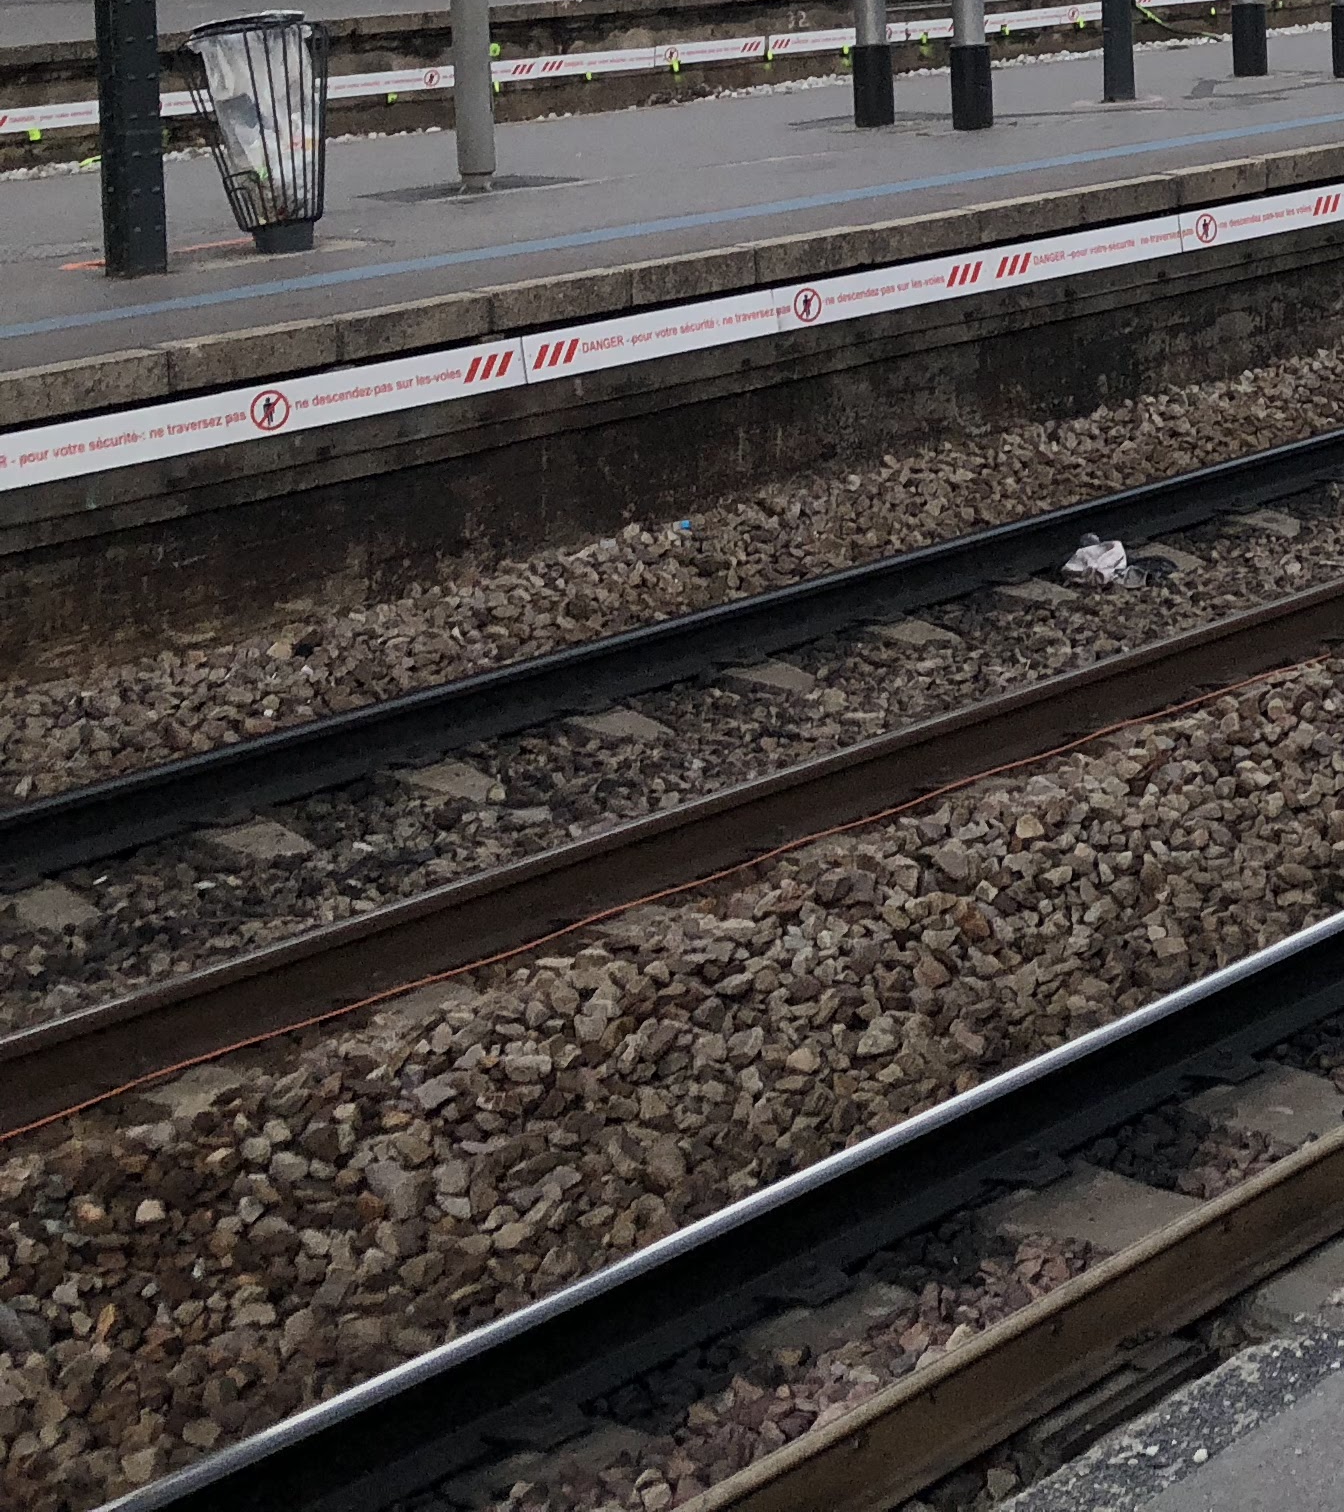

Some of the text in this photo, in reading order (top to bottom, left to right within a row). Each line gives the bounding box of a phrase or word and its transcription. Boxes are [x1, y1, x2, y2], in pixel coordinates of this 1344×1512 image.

[581, 334, 625, 354] DANGER
[631, 332, 653, 347] pour
[654, 325, 678, 339] votre
[722, 316, 734, 326] ne
[775, 304, 792, 318] pas
[294, 398, 310, 411] ne
[373, 381, 394, 398] pas
[395, 377, 413, 390] sur
[415, 374, 432, 387] les
[432, 366, 462, 383] voies
[19, 449, 49, 467] pour
[52, 443, 86, 459] votre
[149, 427, 165, 439] ne
[225, 409, 247, 428] pas
